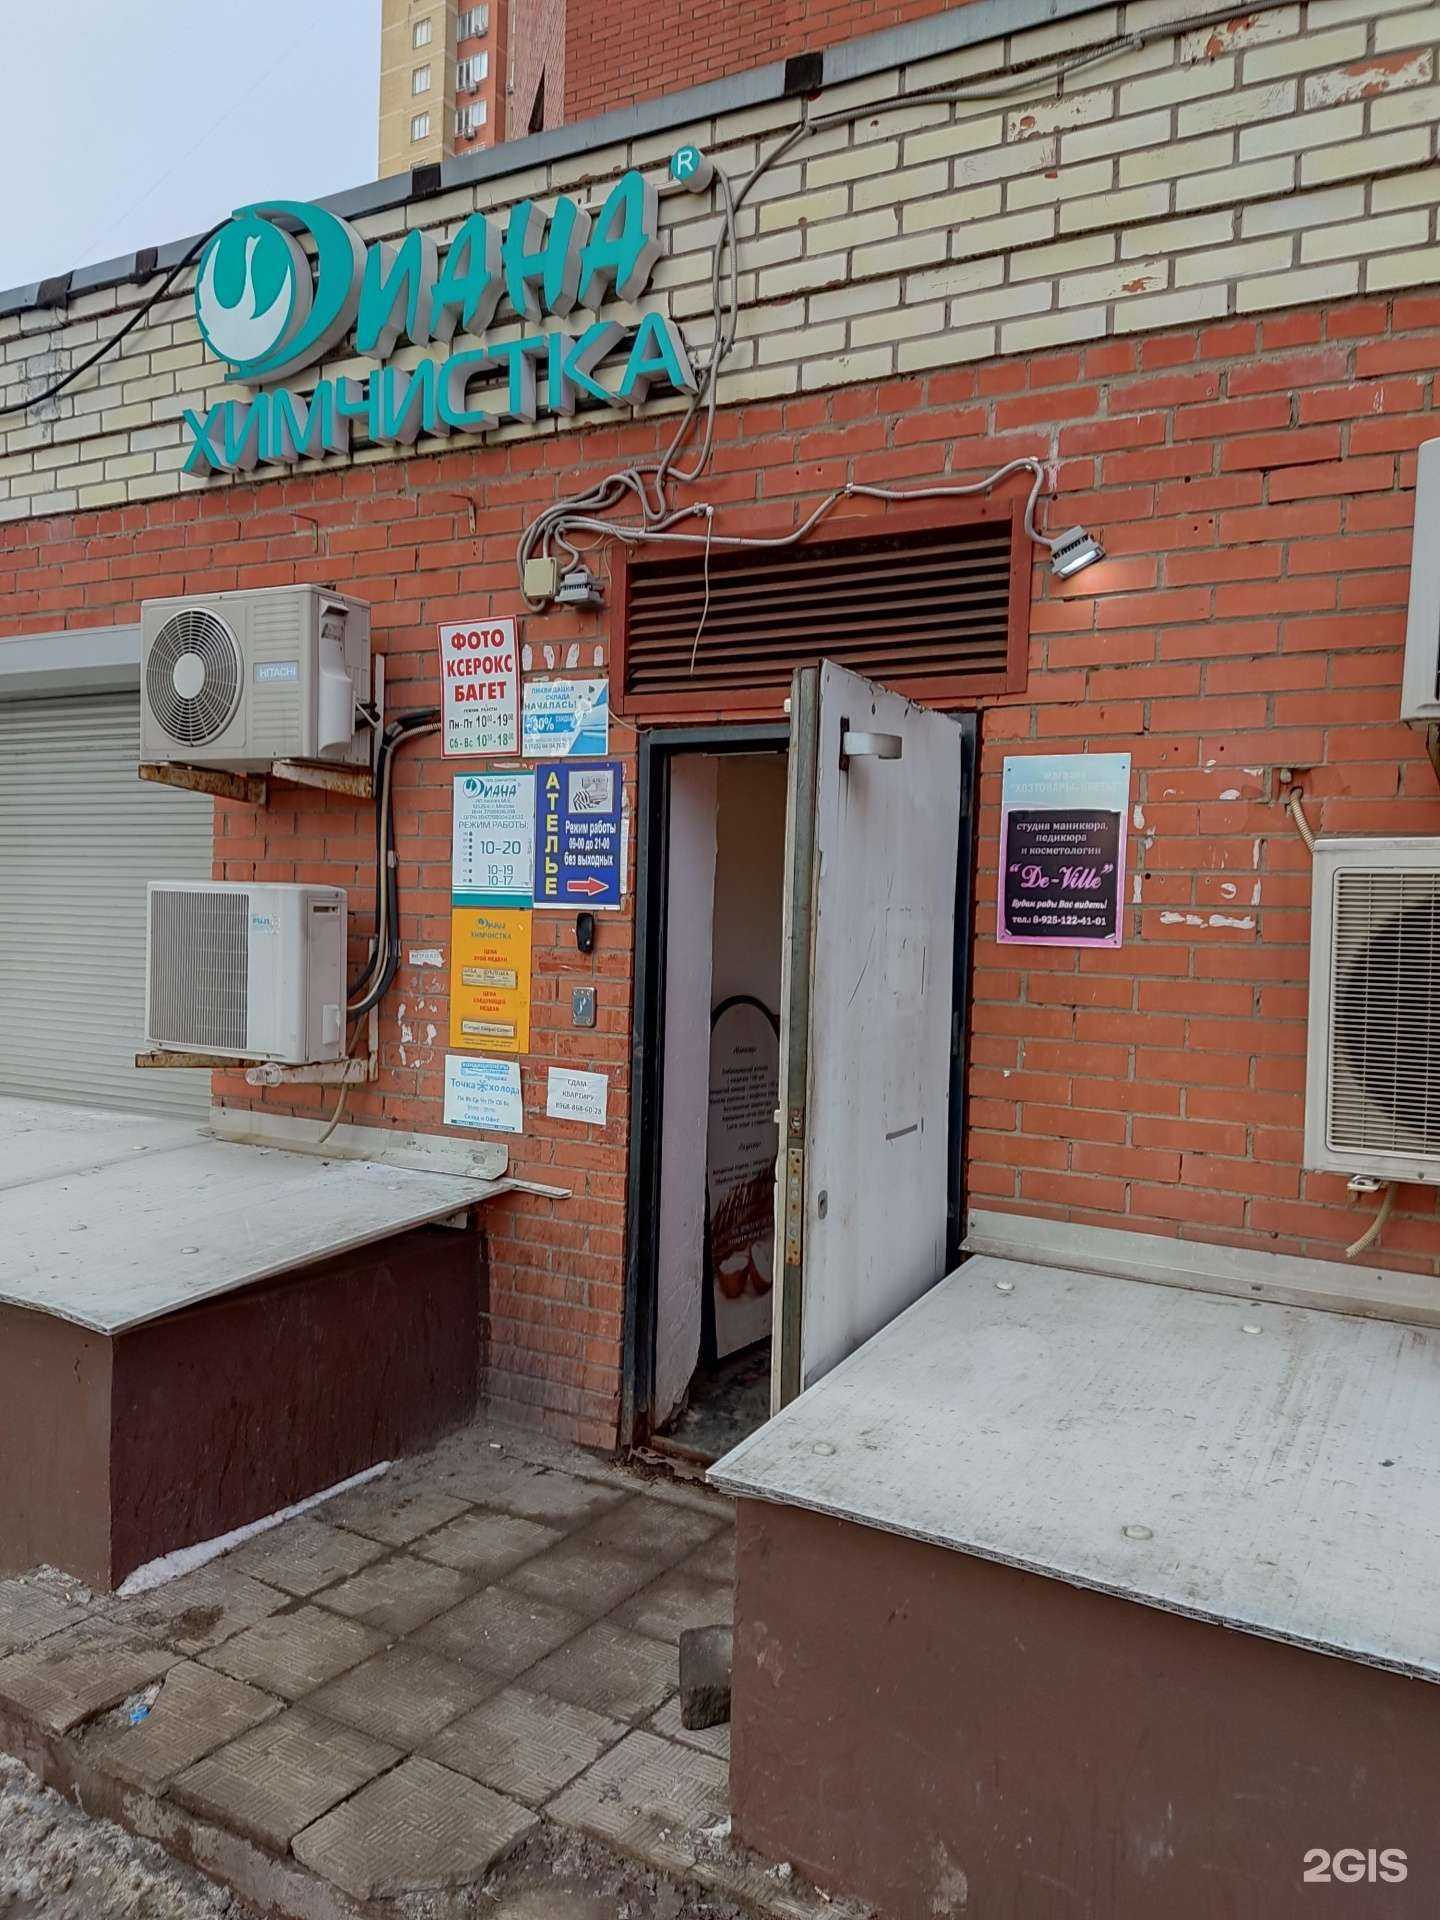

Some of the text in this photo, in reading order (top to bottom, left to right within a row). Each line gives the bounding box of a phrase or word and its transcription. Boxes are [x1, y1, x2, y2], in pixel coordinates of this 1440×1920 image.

[182, 311, 698, 477] ХИМЧИСТКА
[450, 628, 505, 651] ФОТО
[446, 654, 513, 678] КСЕРОКС
[260, 666, 296, 679] HITACHI
[454, 681, 507, 702] БАГЕТ
[524, 700, 577, 710] НАЧАЛАСЬ!
[458, 820, 491, 830] РЕЖИМ
[564, 820, 617, 835] Режим работы
[1016, 821, 1050, 832] студия
[1036, 833, 1087, 844] педикюра
[480, 840, 521, 855] 10-20
[1029, 846, 1101, 856] косметологии
[563, 851, 614, 868] без выходных
[487, 864, 514, 875] 10-19
[487, 875, 514, 886] 10-17
[449, 1078, 476, 1089] Точка
[567, 1078, 587, 1087] СДАМ
[562, 1090, 594, 1101] КВАРТИРУ
